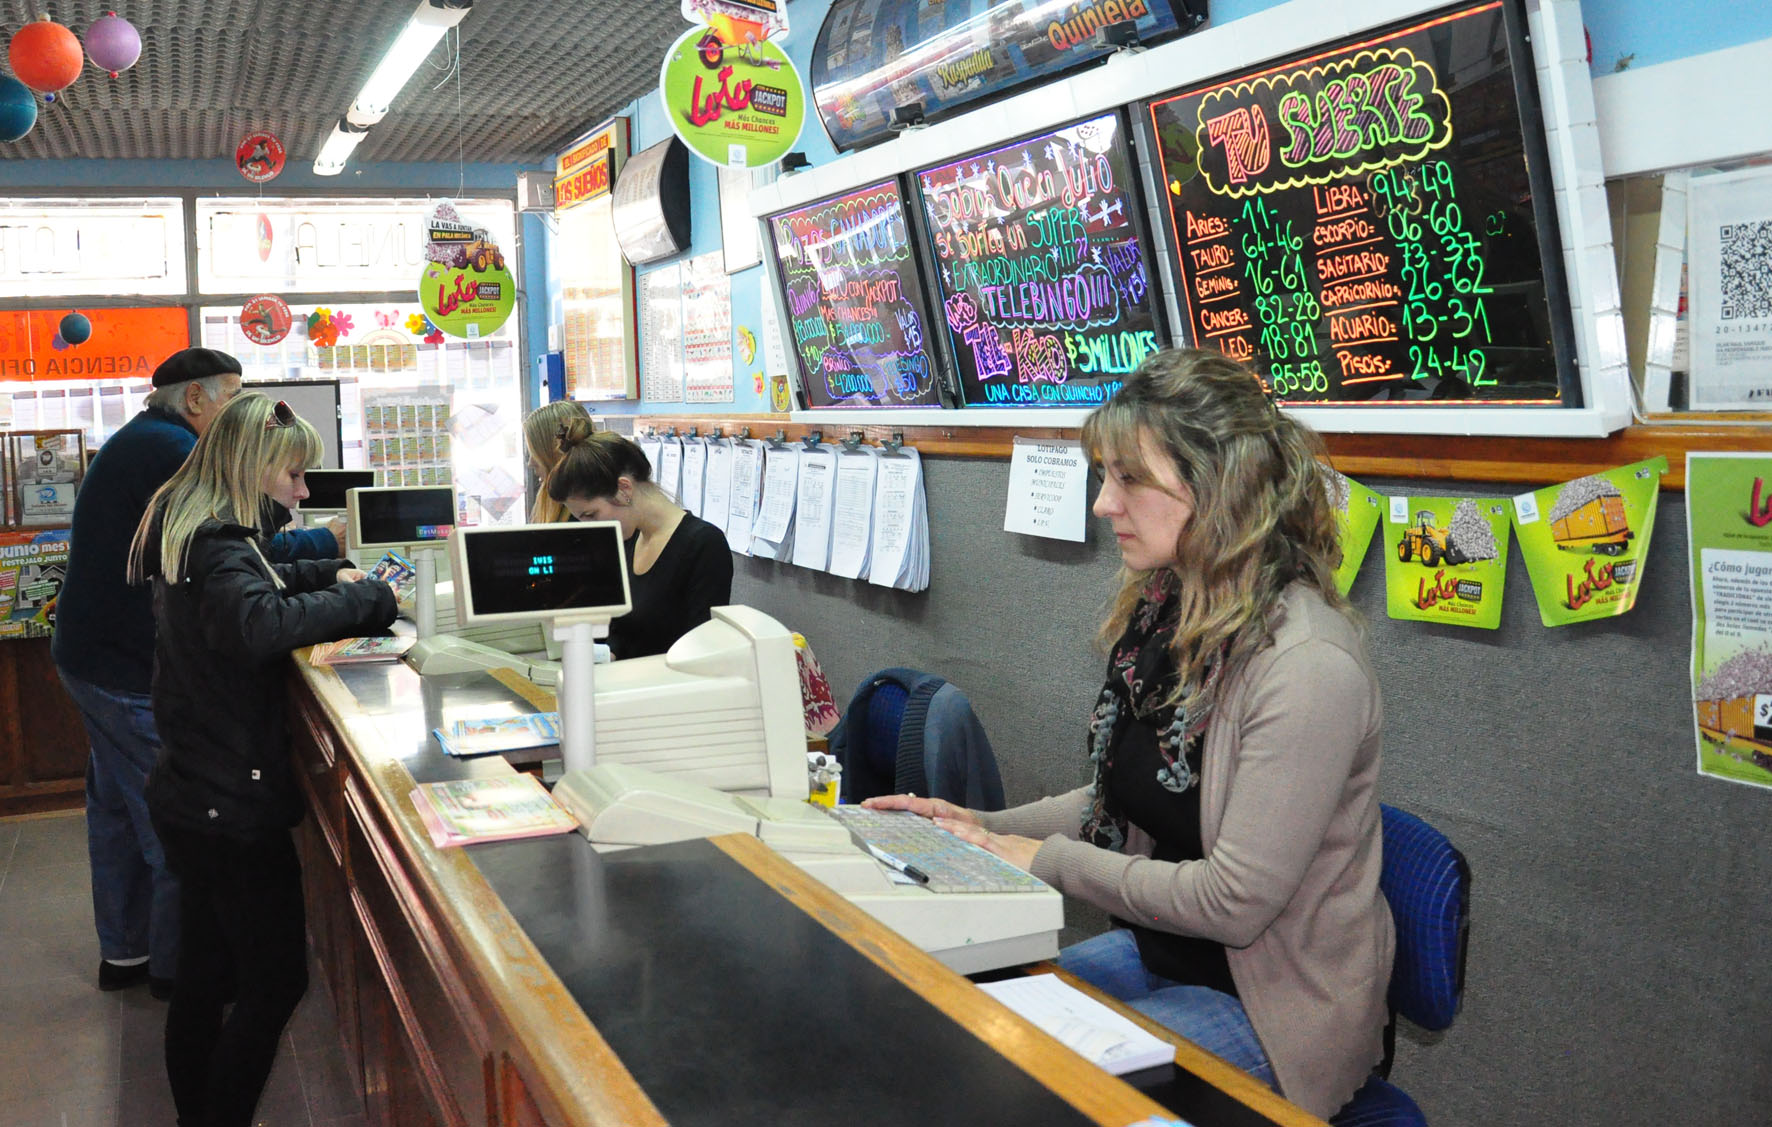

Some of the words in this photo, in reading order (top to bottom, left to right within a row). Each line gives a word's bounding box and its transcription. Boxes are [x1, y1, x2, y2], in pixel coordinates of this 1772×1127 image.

[1047, 0, 1149, 51] Quiniela
[936, 48, 994, 88] Raspadita
[753, 91, 786, 108] JACKPOT
[724, 119, 740, 129] MÁS
[1207, 104, 1270, 183] TU
[1279, 64, 1434, 168] SUERTE
[556, 181, 572, 207] LOS
[574, 162, 608, 200] SUEÑOS
[431, 220, 440, 229] LA
[441, 221, 453, 230] VAS
[1026, 207, 1088, 248] SUPER
[479, 286, 500, 295] JACKPOT
[985, 384, 1010, 402] UNA
[1012, 384, 1040, 402] CASA
[1041, 384, 1060, 402] CON
[1061, 384, 1103, 402] QUINCHO
[1037, 444, 1068, 455] LOTIPAGO
[1026, 455, 1042, 464] SOLO
[1043, 457, 1078, 467] COBRAMOS
[1708, 561, 1742, 573] ¿Cómo
[1458, 583, 1480, 595] JACKPOT
